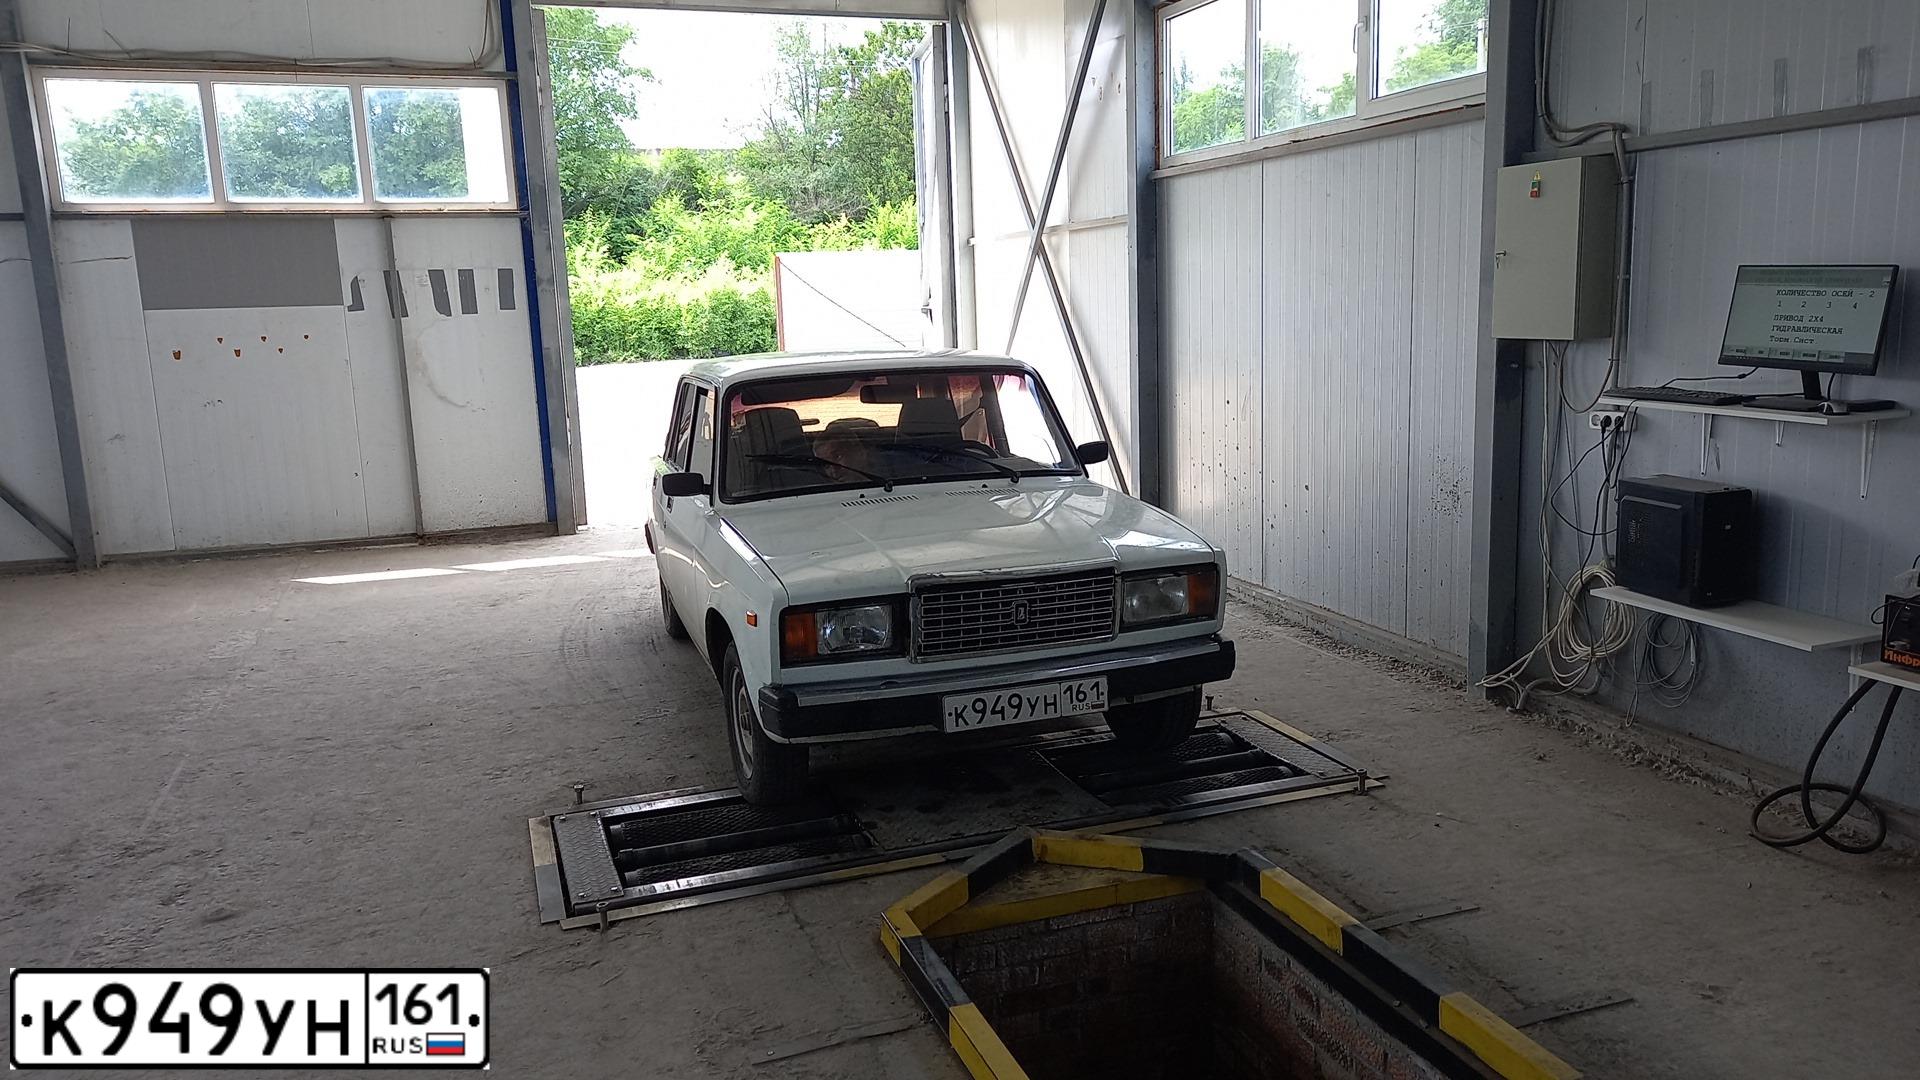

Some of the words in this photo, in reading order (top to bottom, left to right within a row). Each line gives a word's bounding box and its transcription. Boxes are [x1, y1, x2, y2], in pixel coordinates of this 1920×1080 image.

[1776, 288, 1827, 297] КОЛИЧЕСТВО
[1831, 288, 1854, 298] ОСЕЙ
[1868, 290, 1875, 298] 2
[1826, 301, 1832, 309] 3
[1852, 302, 1858, 310] 4
[1773, 314, 1804, 323] ПРИВОД
[1771, 325, 1844, 335] ГИДРАВЛИЧЕСКАЯ
[1063, 680, 1101, 705] 161
[1071, 702, 1091, 712] RUS
